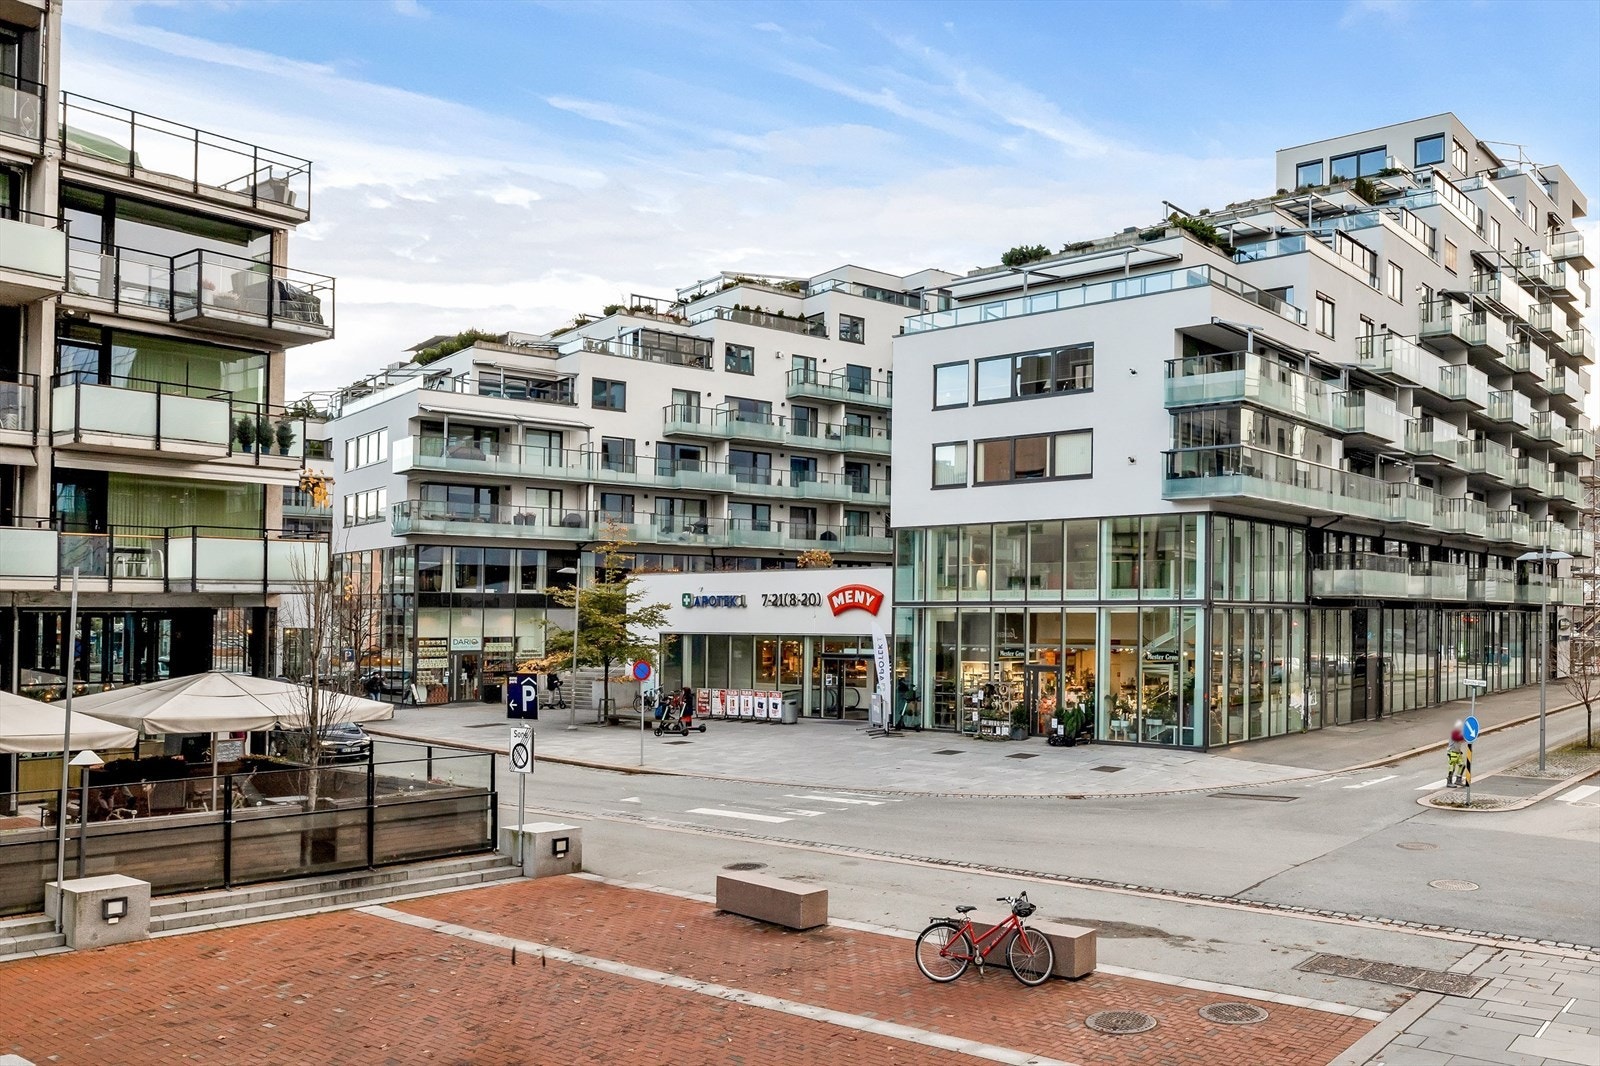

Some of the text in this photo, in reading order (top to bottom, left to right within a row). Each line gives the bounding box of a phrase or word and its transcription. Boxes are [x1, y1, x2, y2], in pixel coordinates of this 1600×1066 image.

[694, 595, 738, 607] APOTEK
[761, 592, 822, 607] 7-21(8-20)
[831, 590, 875, 607] MENY
[522, 685, 535, 711] P
[513, 729, 529, 738] Sone
